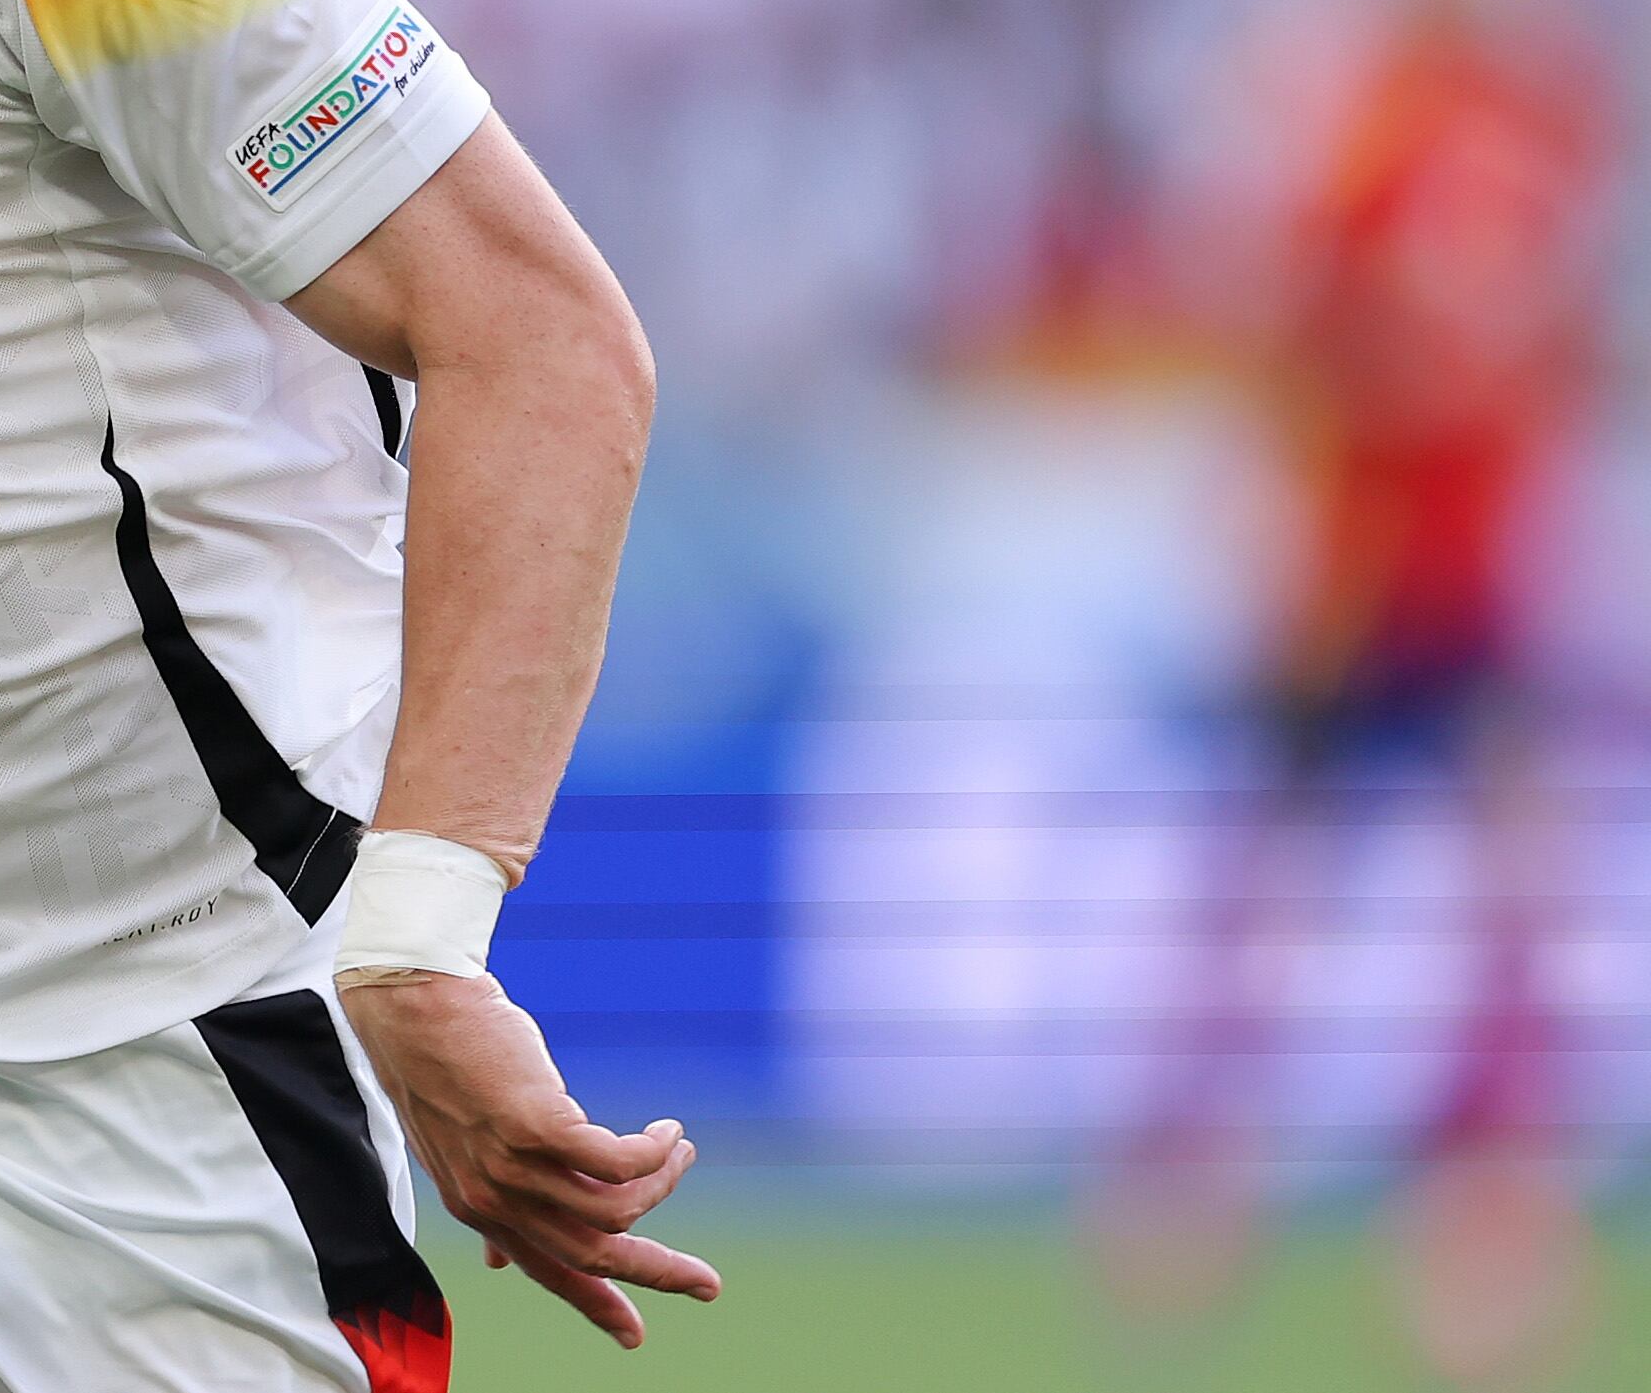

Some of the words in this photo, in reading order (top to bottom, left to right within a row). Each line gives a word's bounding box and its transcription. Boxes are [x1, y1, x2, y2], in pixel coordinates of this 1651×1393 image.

[247, 13, 421, 188] FOUNDATION
[394, 73, 408, 97] for
[235, 122, 281, 166] UEFA
